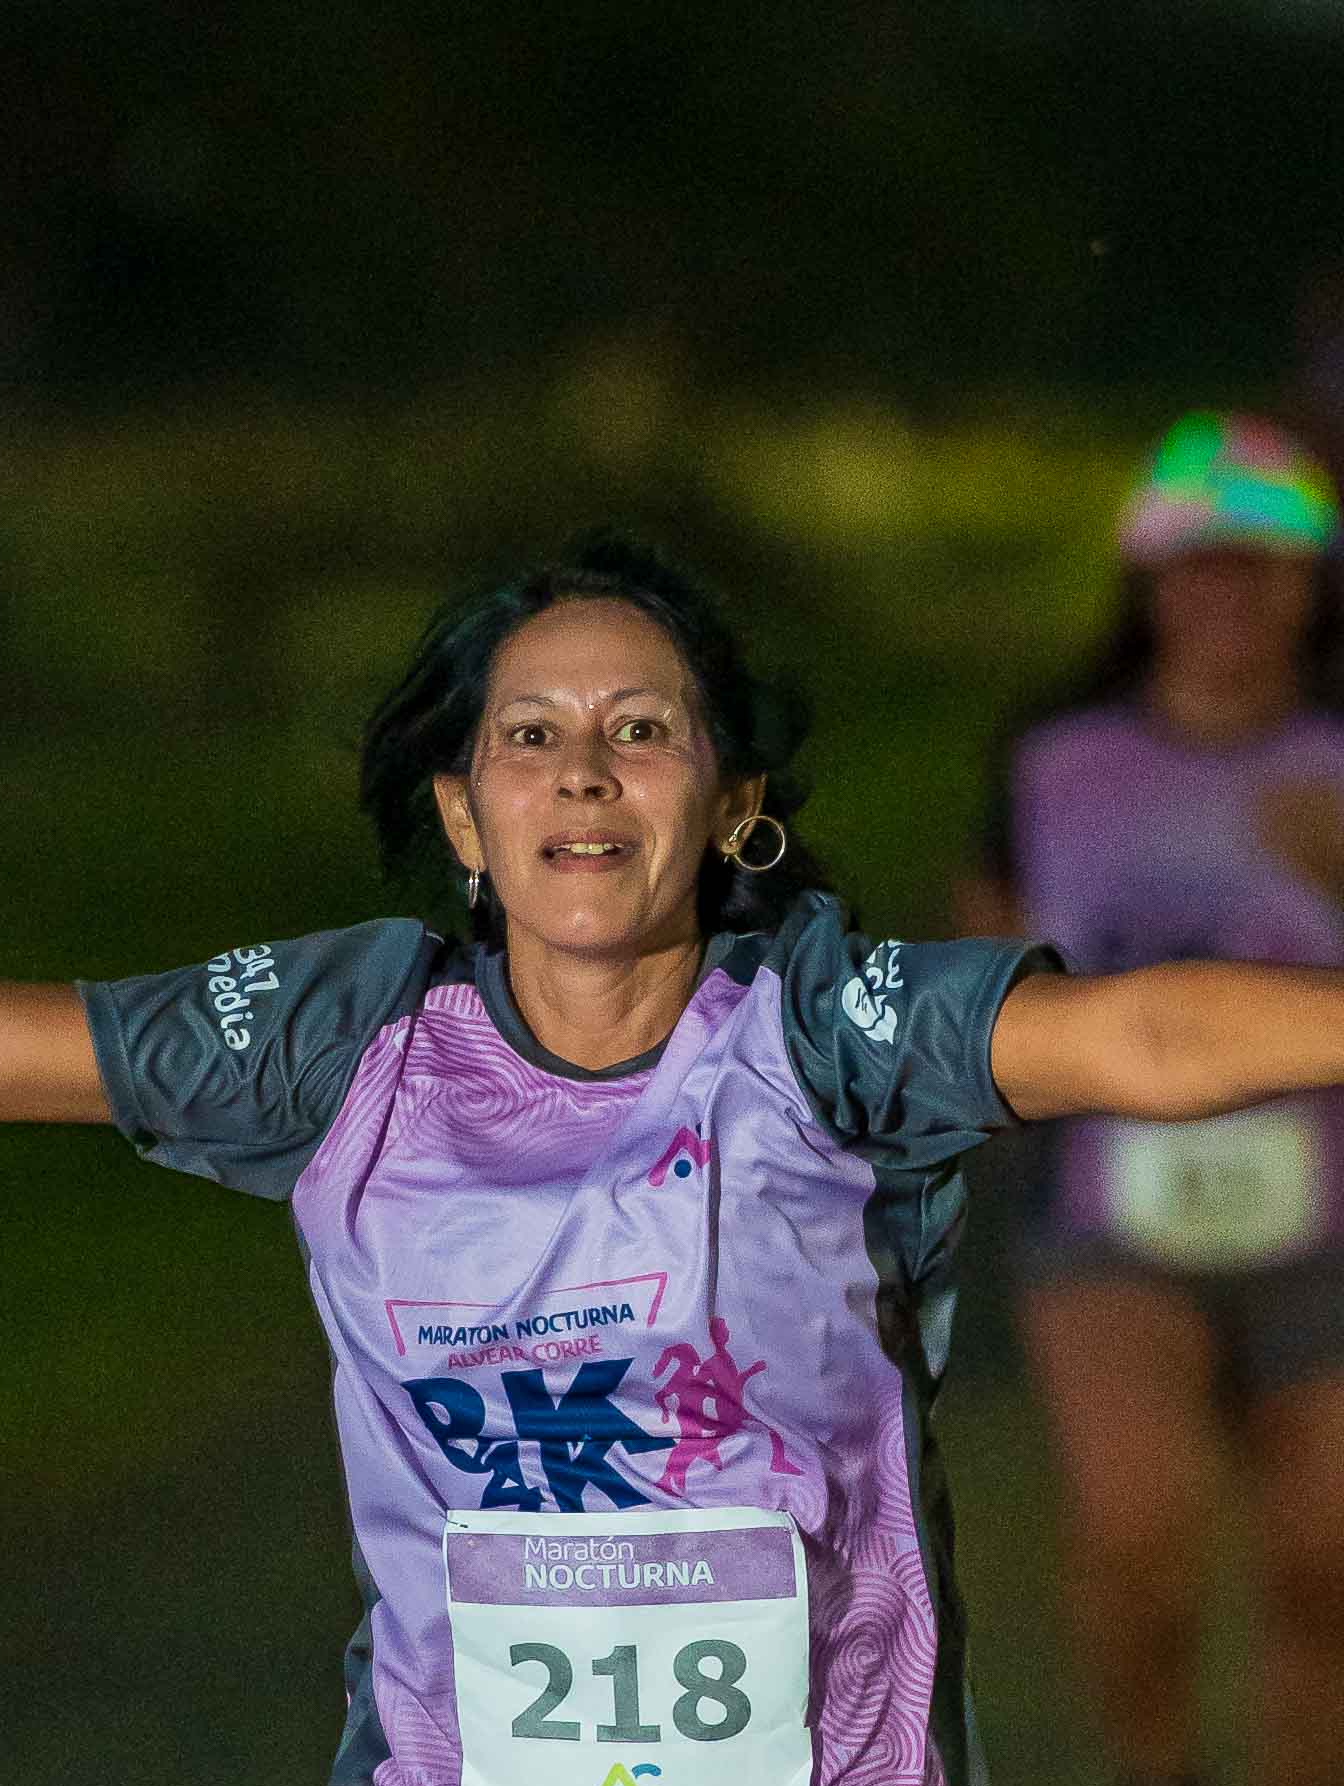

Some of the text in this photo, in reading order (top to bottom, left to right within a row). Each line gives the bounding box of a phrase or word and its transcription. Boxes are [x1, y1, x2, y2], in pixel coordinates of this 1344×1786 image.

[516, 1303, 635, 1339] NOCTURNA
[448, 1334, 602, 1369] ALVEAR CORRE
[524, 1536, 635, 1562] Maratón
[523, 1560, 716, 1590] NOCTURNA
[508, 1639, 752, 1743] 218
